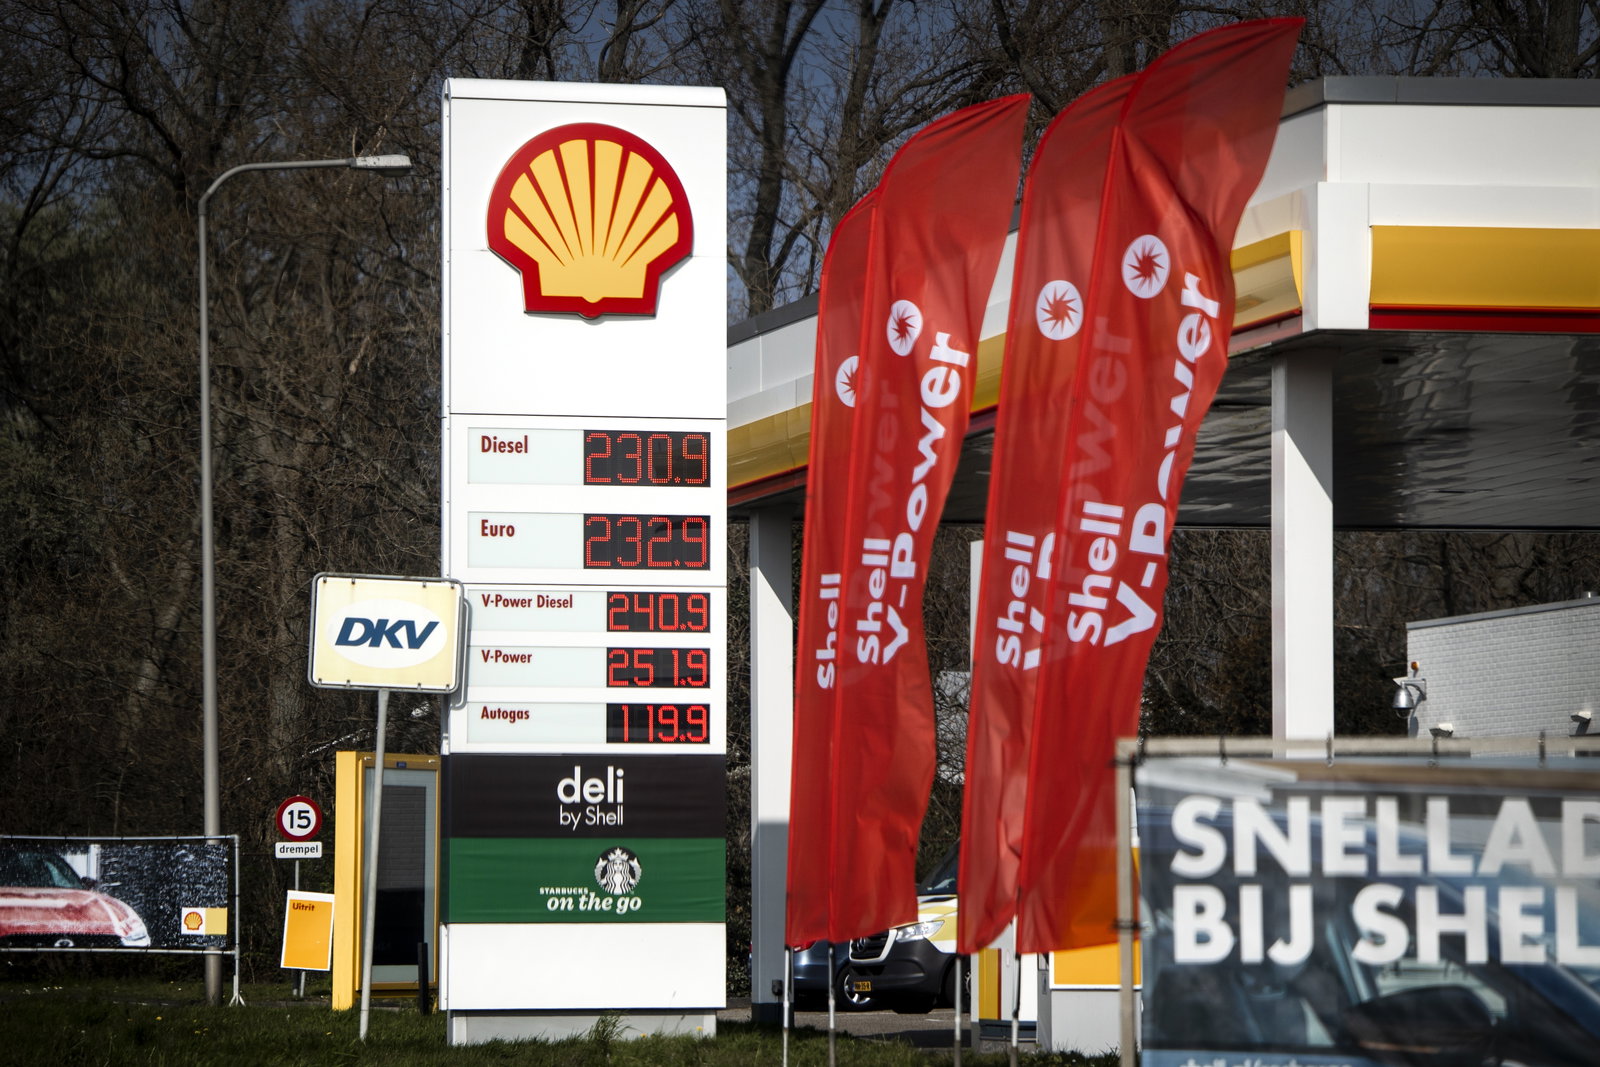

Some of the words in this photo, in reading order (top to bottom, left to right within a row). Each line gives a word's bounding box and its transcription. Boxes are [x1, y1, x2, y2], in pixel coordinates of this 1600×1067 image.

[480, 435, 529, 454] Diesel
[586, 433, 707, 484] 230.9
[883, 331, 970, 665] V-Power
[480, 519, 516, 538] Euro
[586, 516, 707, 567] 232.9
[1067, 500, 1124, 646] Shell
[481, 594, 533, 609] V-Power
[536, 594, 574, 609] Diesel
[609, 594, 708, 631] 240.9
[856, 538, 891, 665] Shell
[995, 530, 1035, 669] Shell
[334, 616, 440, 650] DKV
[815, 572, 842, 690] Shell
[481, 649, 533, 664] V-Power
[608, 649, 708, 687] 251.9
[480, 706, 530, 723] Autogas
[621, 705, 708, 742] 119.9
[556, 765, 625, 804] deli
[287, 810, 312, 829] 15
[559, 804, 582, 831] by
[585, 804, 624, 826] Shell
[279, 844, 319, 855] drempel
[292, 902, 315, 912] Uitrit
[539, 887, 588, 895] STARBUCKS
[547, 896, 574, 911] on
[578, 892, 612, 911] the
[616, 896, 642, 914] go
[1173, 884, 1315, 966] BIJ
